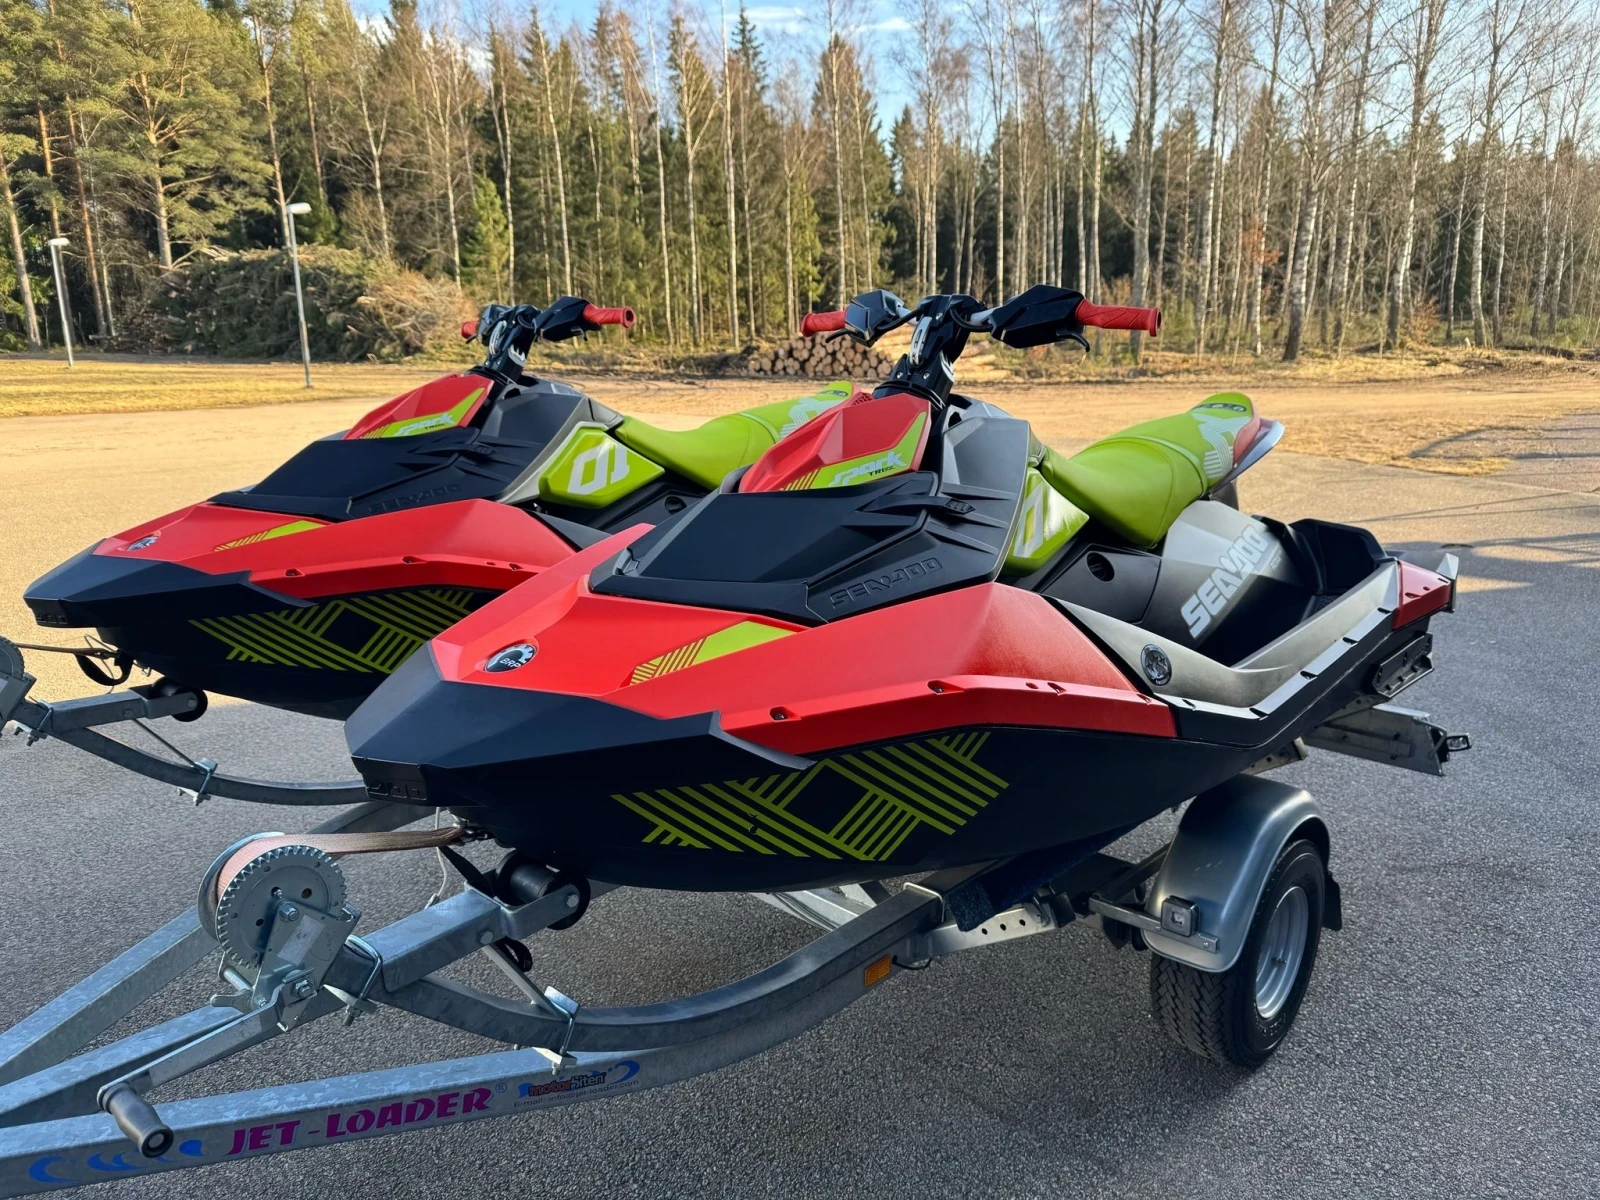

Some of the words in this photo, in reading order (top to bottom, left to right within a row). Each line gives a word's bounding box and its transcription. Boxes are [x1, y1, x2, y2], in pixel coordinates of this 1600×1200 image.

[567, 440, 630, 496] 01
[499, 657, 522, 668] BRP
[548, 1079, 640, 1102] info@jet-loader.com
